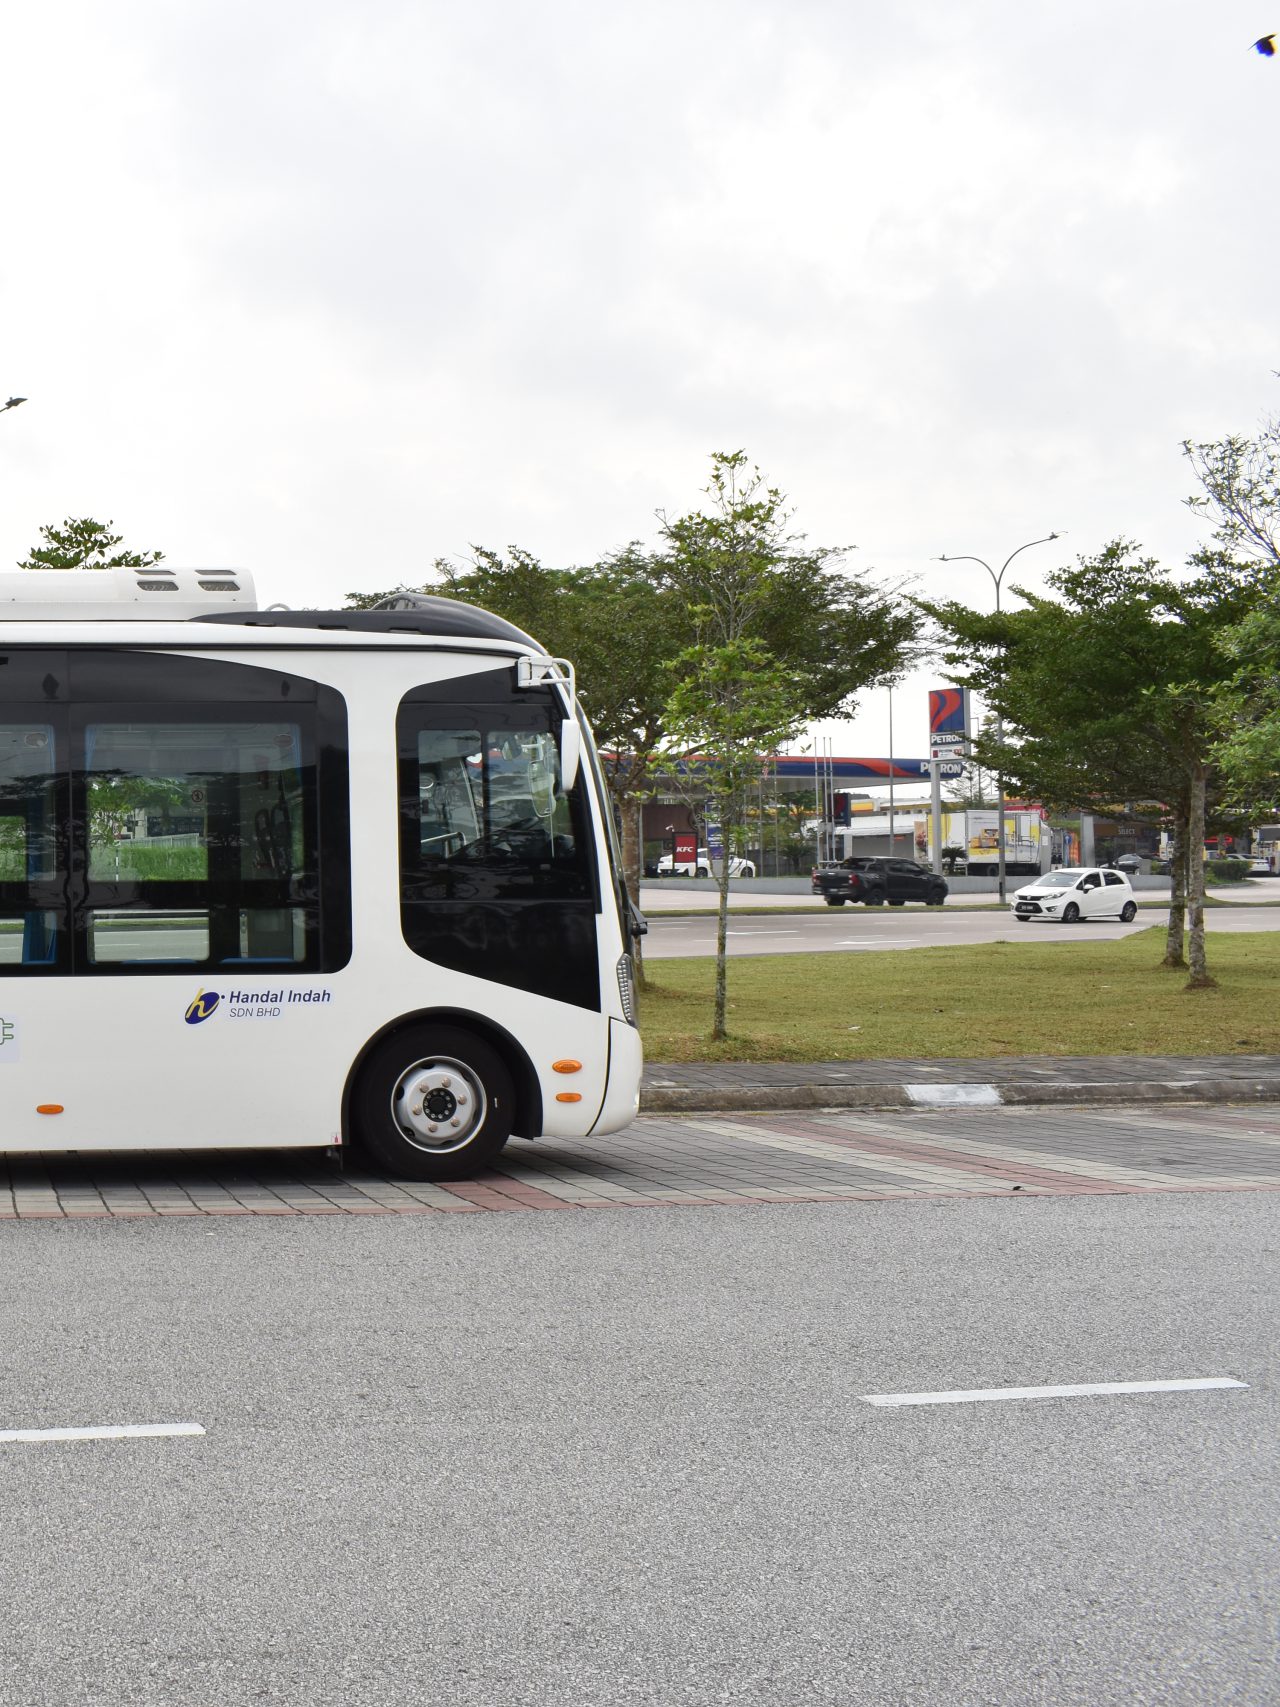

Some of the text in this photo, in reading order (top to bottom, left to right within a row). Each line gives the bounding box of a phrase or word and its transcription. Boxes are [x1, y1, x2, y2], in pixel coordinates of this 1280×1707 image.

[920, 762, 961, 774] PRON
[229, 989, 331, 1004] Handal Indah
[229, 1007, 281, 1018] SDN BHD
